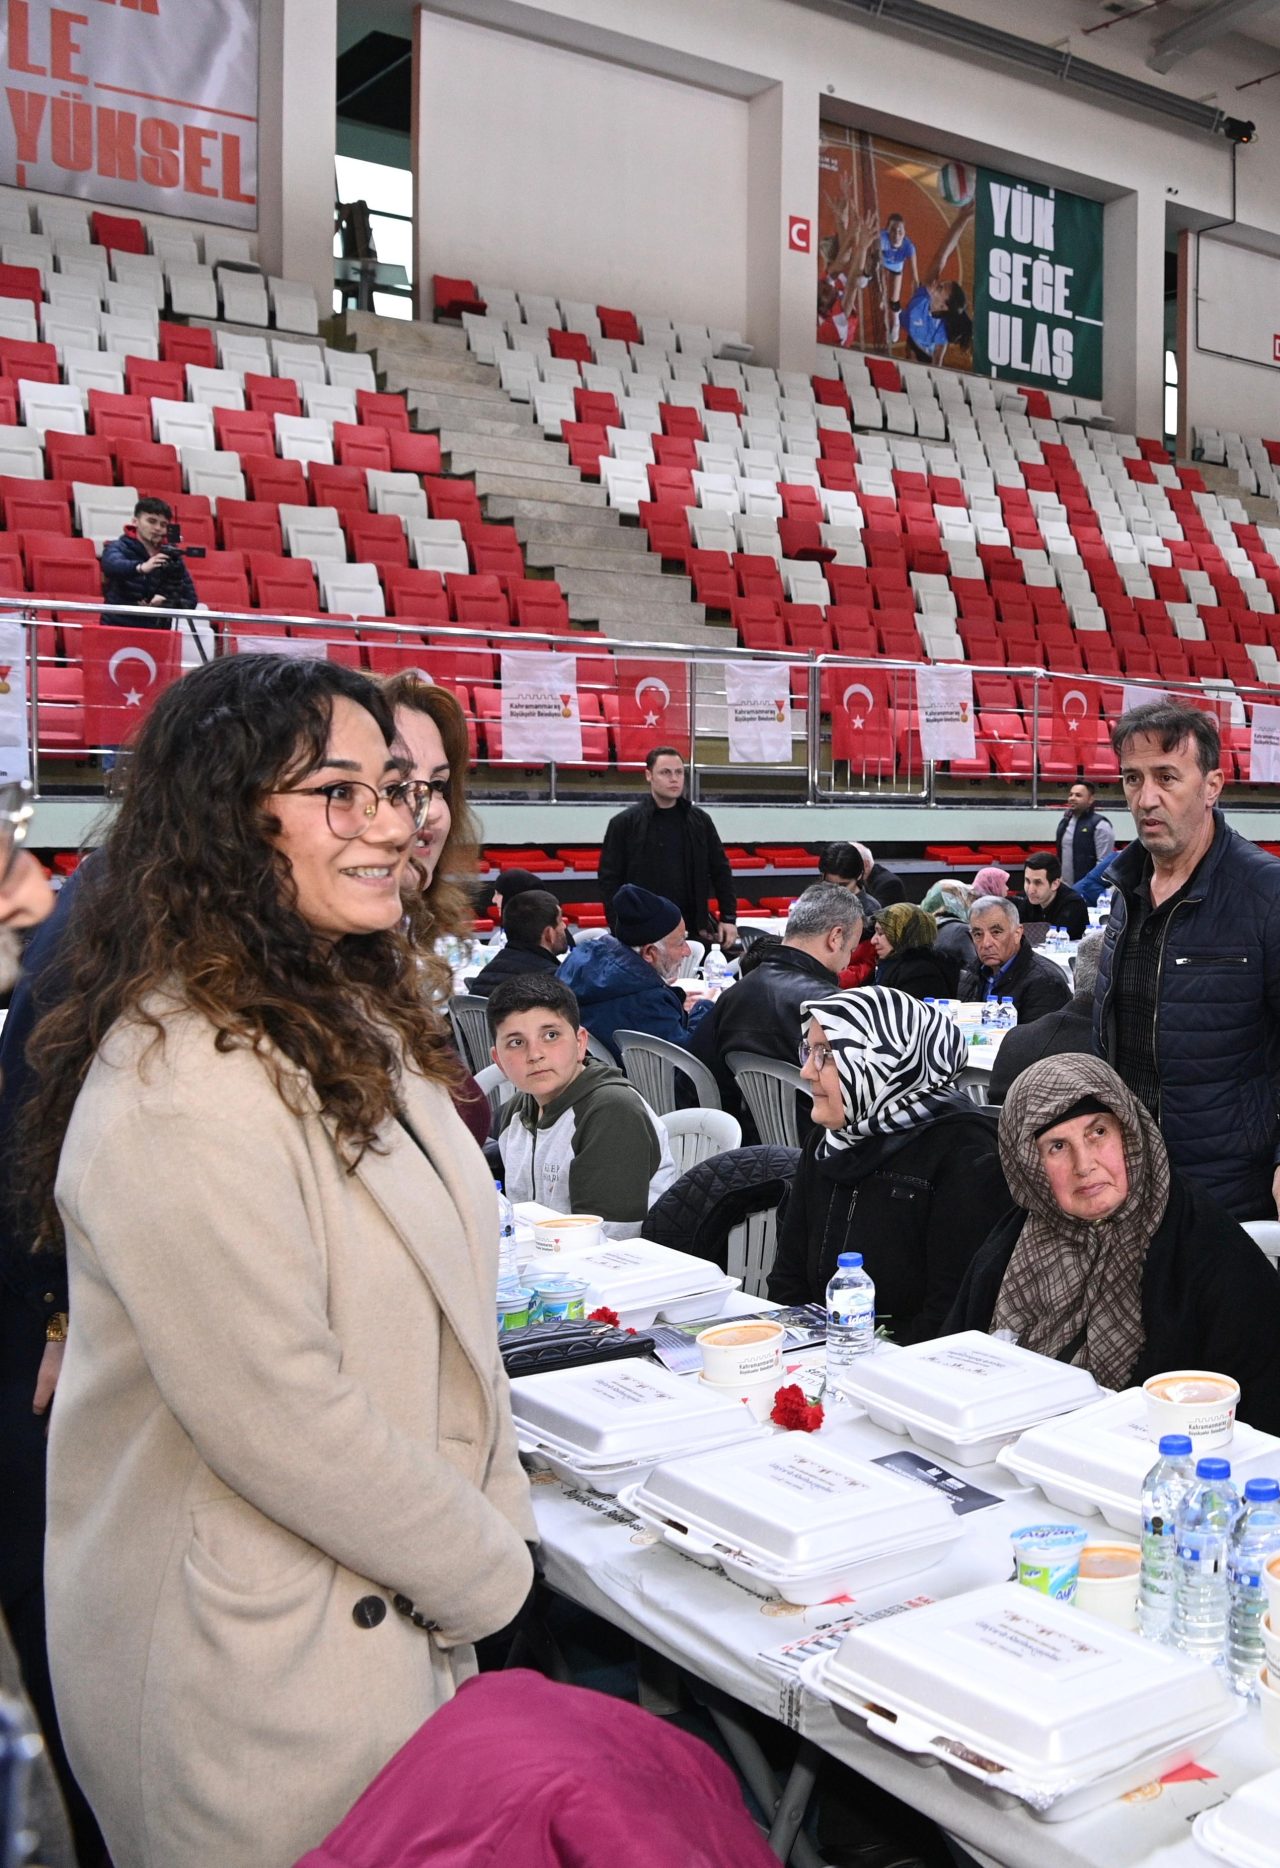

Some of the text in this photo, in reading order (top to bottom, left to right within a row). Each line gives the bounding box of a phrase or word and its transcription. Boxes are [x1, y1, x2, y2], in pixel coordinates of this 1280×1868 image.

[5, 87, 256, 205] YÜKSEL
[790, 222, 808, 247] C
[989, 182, 1055, 252] YÜK
[987, 311, 1074, 385] ULAŞ
[509, 703, 561, 711] Kahramanmaraş
